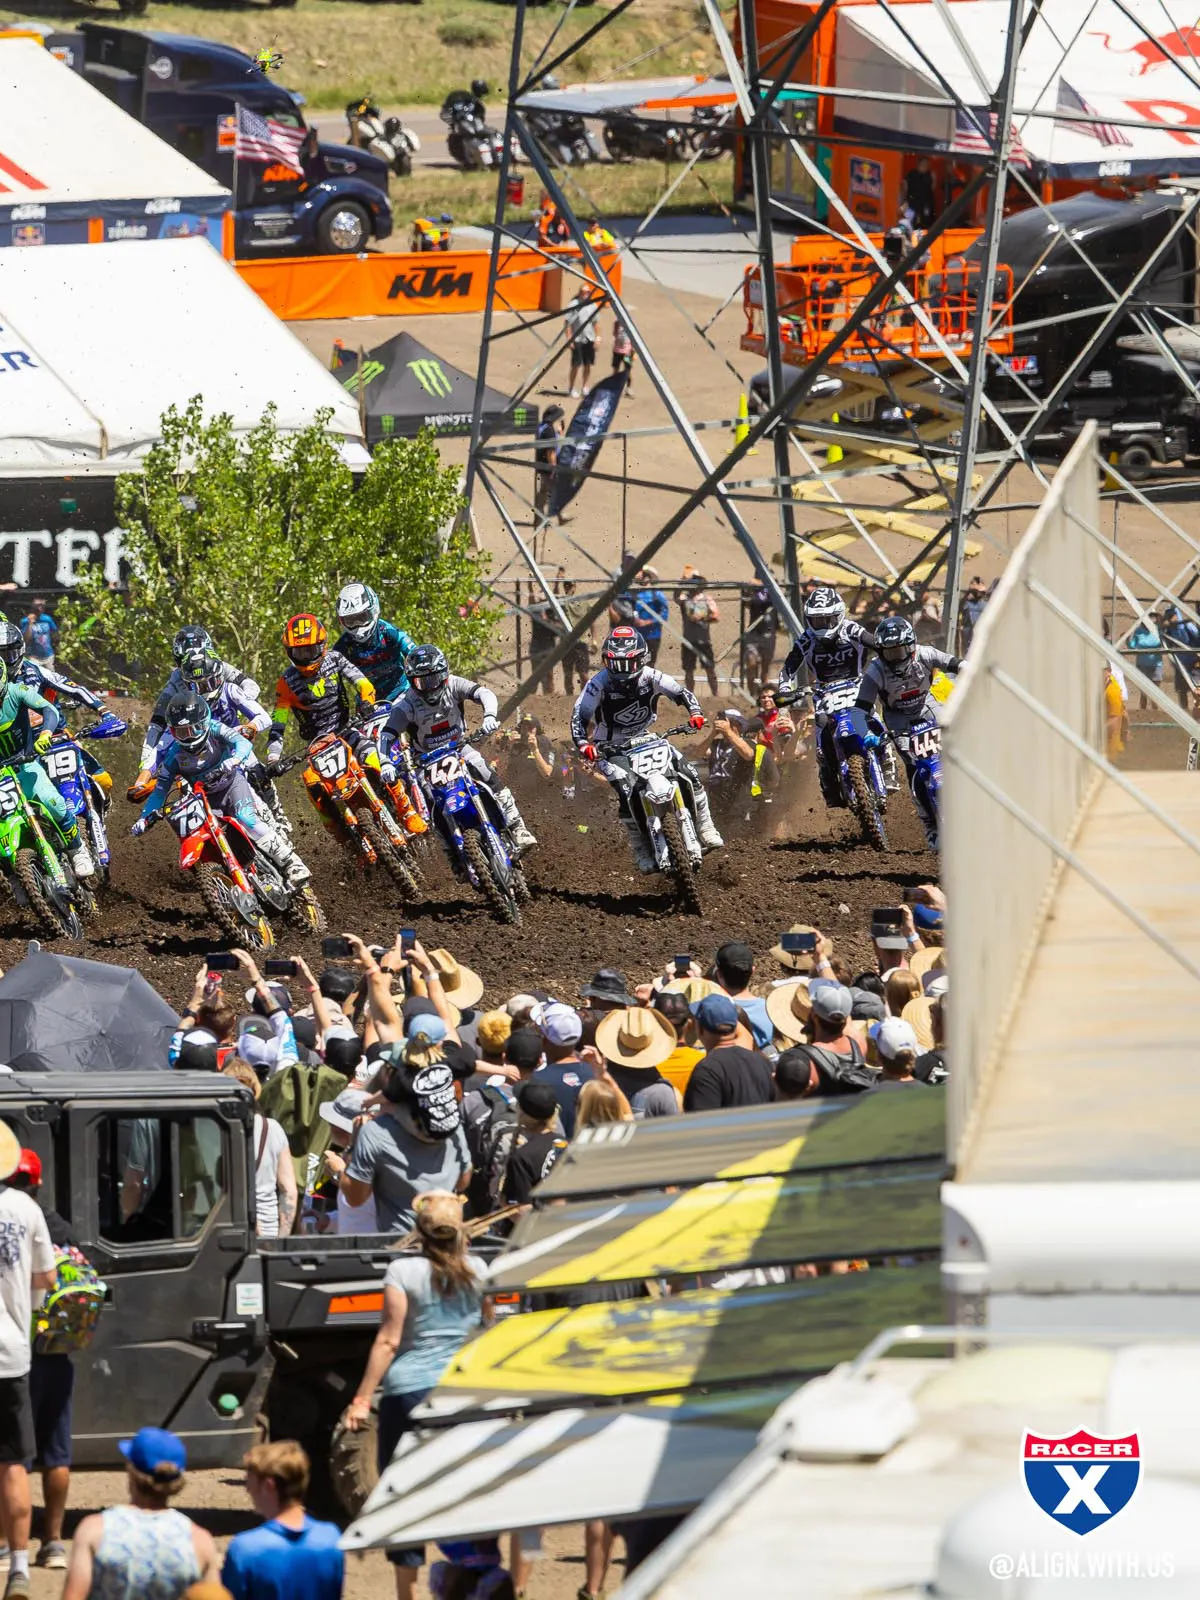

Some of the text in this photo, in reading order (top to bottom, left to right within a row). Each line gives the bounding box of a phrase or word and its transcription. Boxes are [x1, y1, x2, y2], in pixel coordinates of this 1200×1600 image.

[387, 265, 473, 299] KTM
[41, 749, 78, 779] 19
[316, 746, 348, 778] 57
[427, 757, 462, 785] 42
[631, 749, 668, 775] 159
[170, 799, 205, 838] 73
